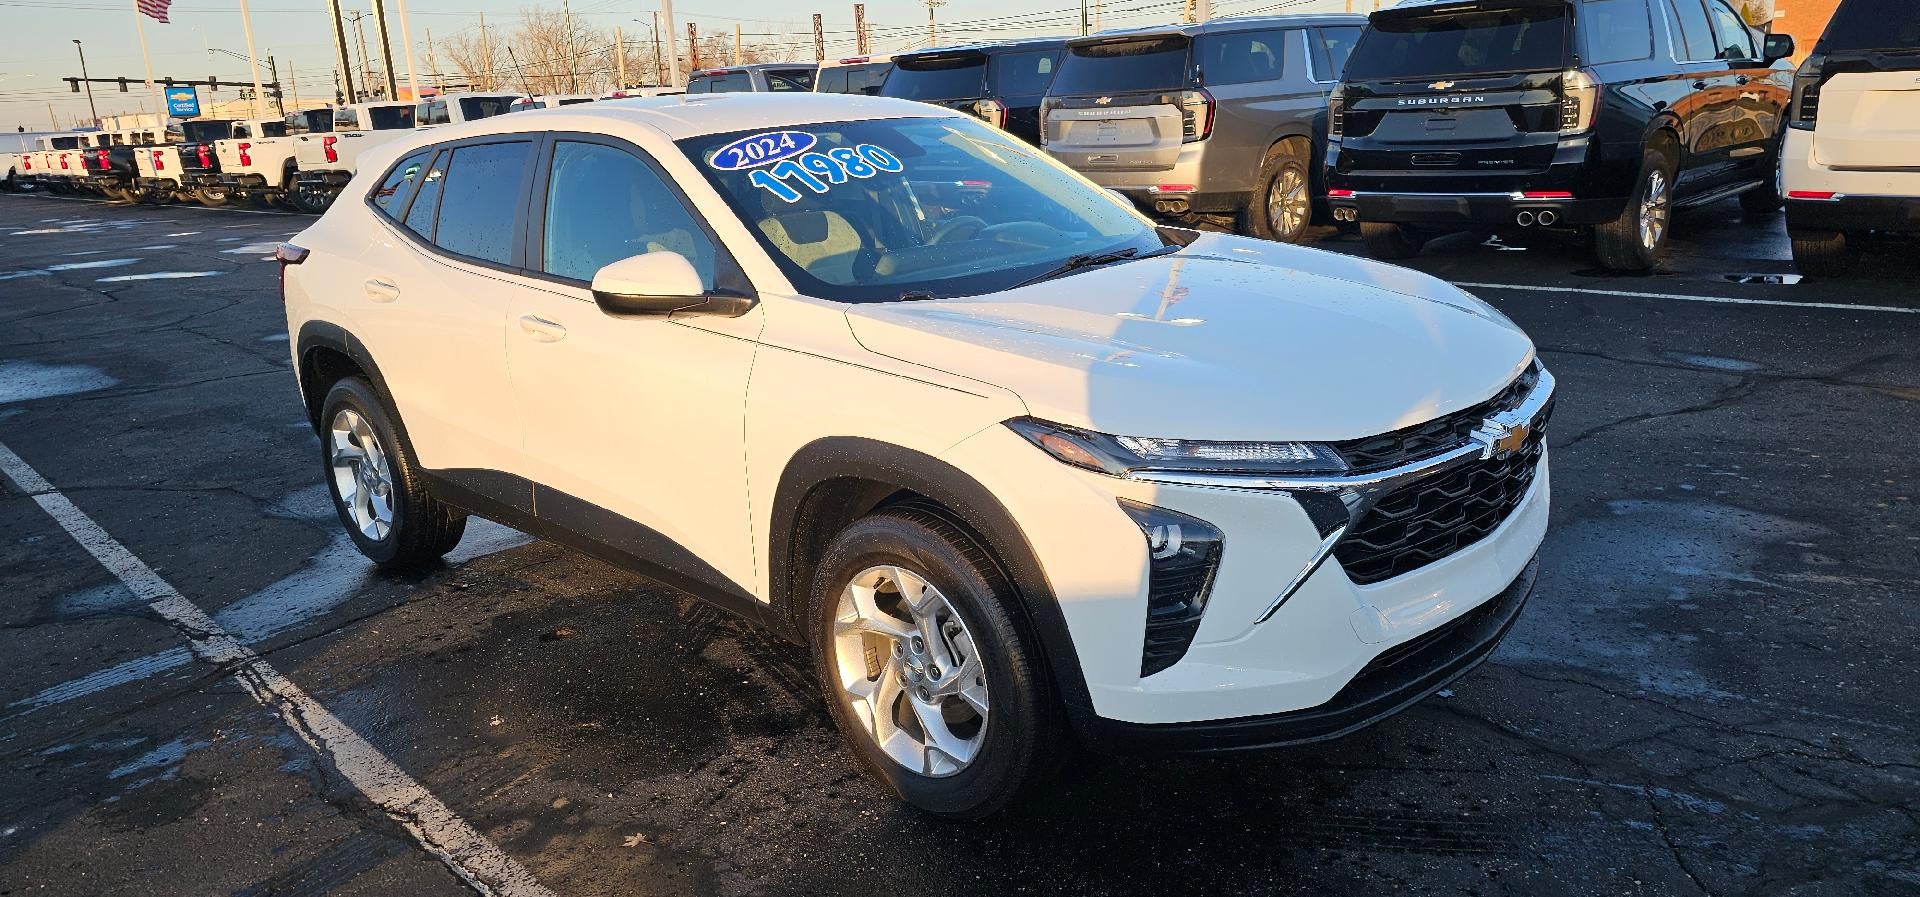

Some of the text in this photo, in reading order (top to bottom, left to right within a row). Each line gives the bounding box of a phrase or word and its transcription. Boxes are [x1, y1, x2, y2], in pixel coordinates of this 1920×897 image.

[1398, 96, 1484, 105] SUBURBAN
[728, 132, 796, 168] 2024
[748, 144, 904, 203] 17980
